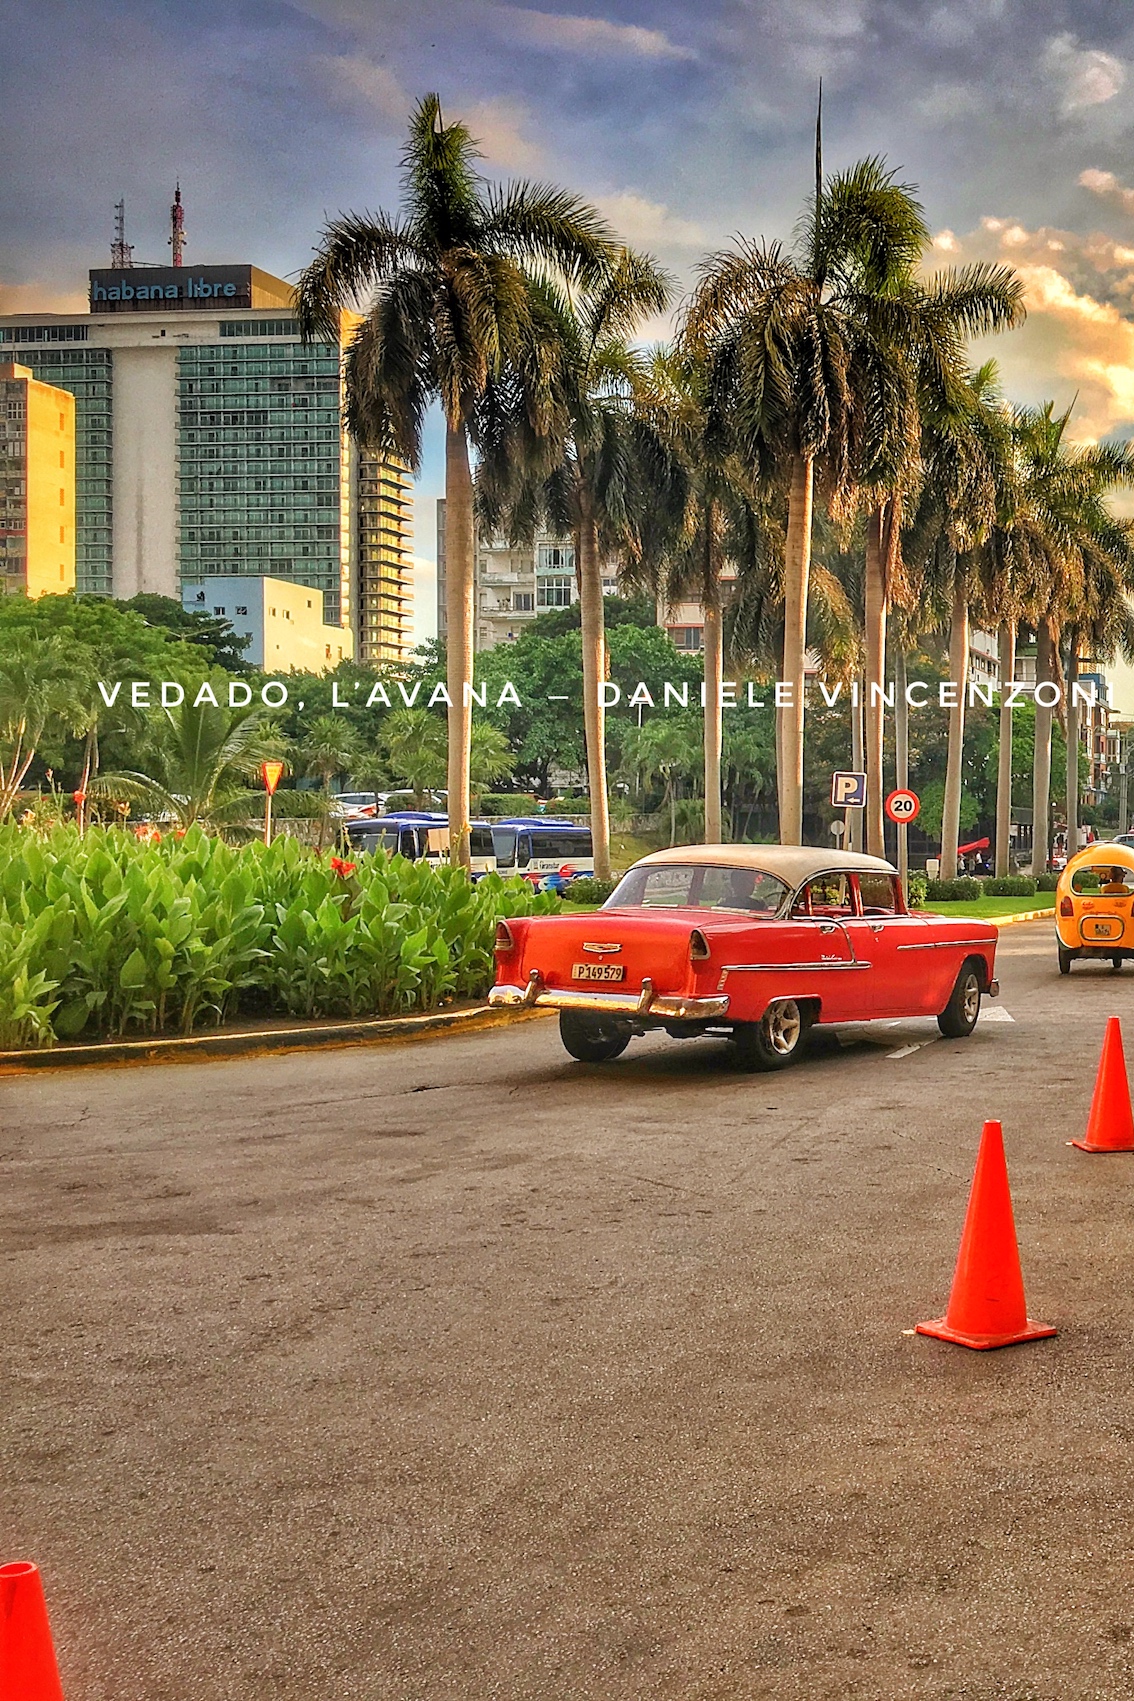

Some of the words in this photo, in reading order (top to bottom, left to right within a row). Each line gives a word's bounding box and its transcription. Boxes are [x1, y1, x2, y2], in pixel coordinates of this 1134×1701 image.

[93, 278, 178, 301] habana
[187, 276, 237, 298] libre
[836, 776, 859, 802] P
[894, 800, 913, 812] 20
